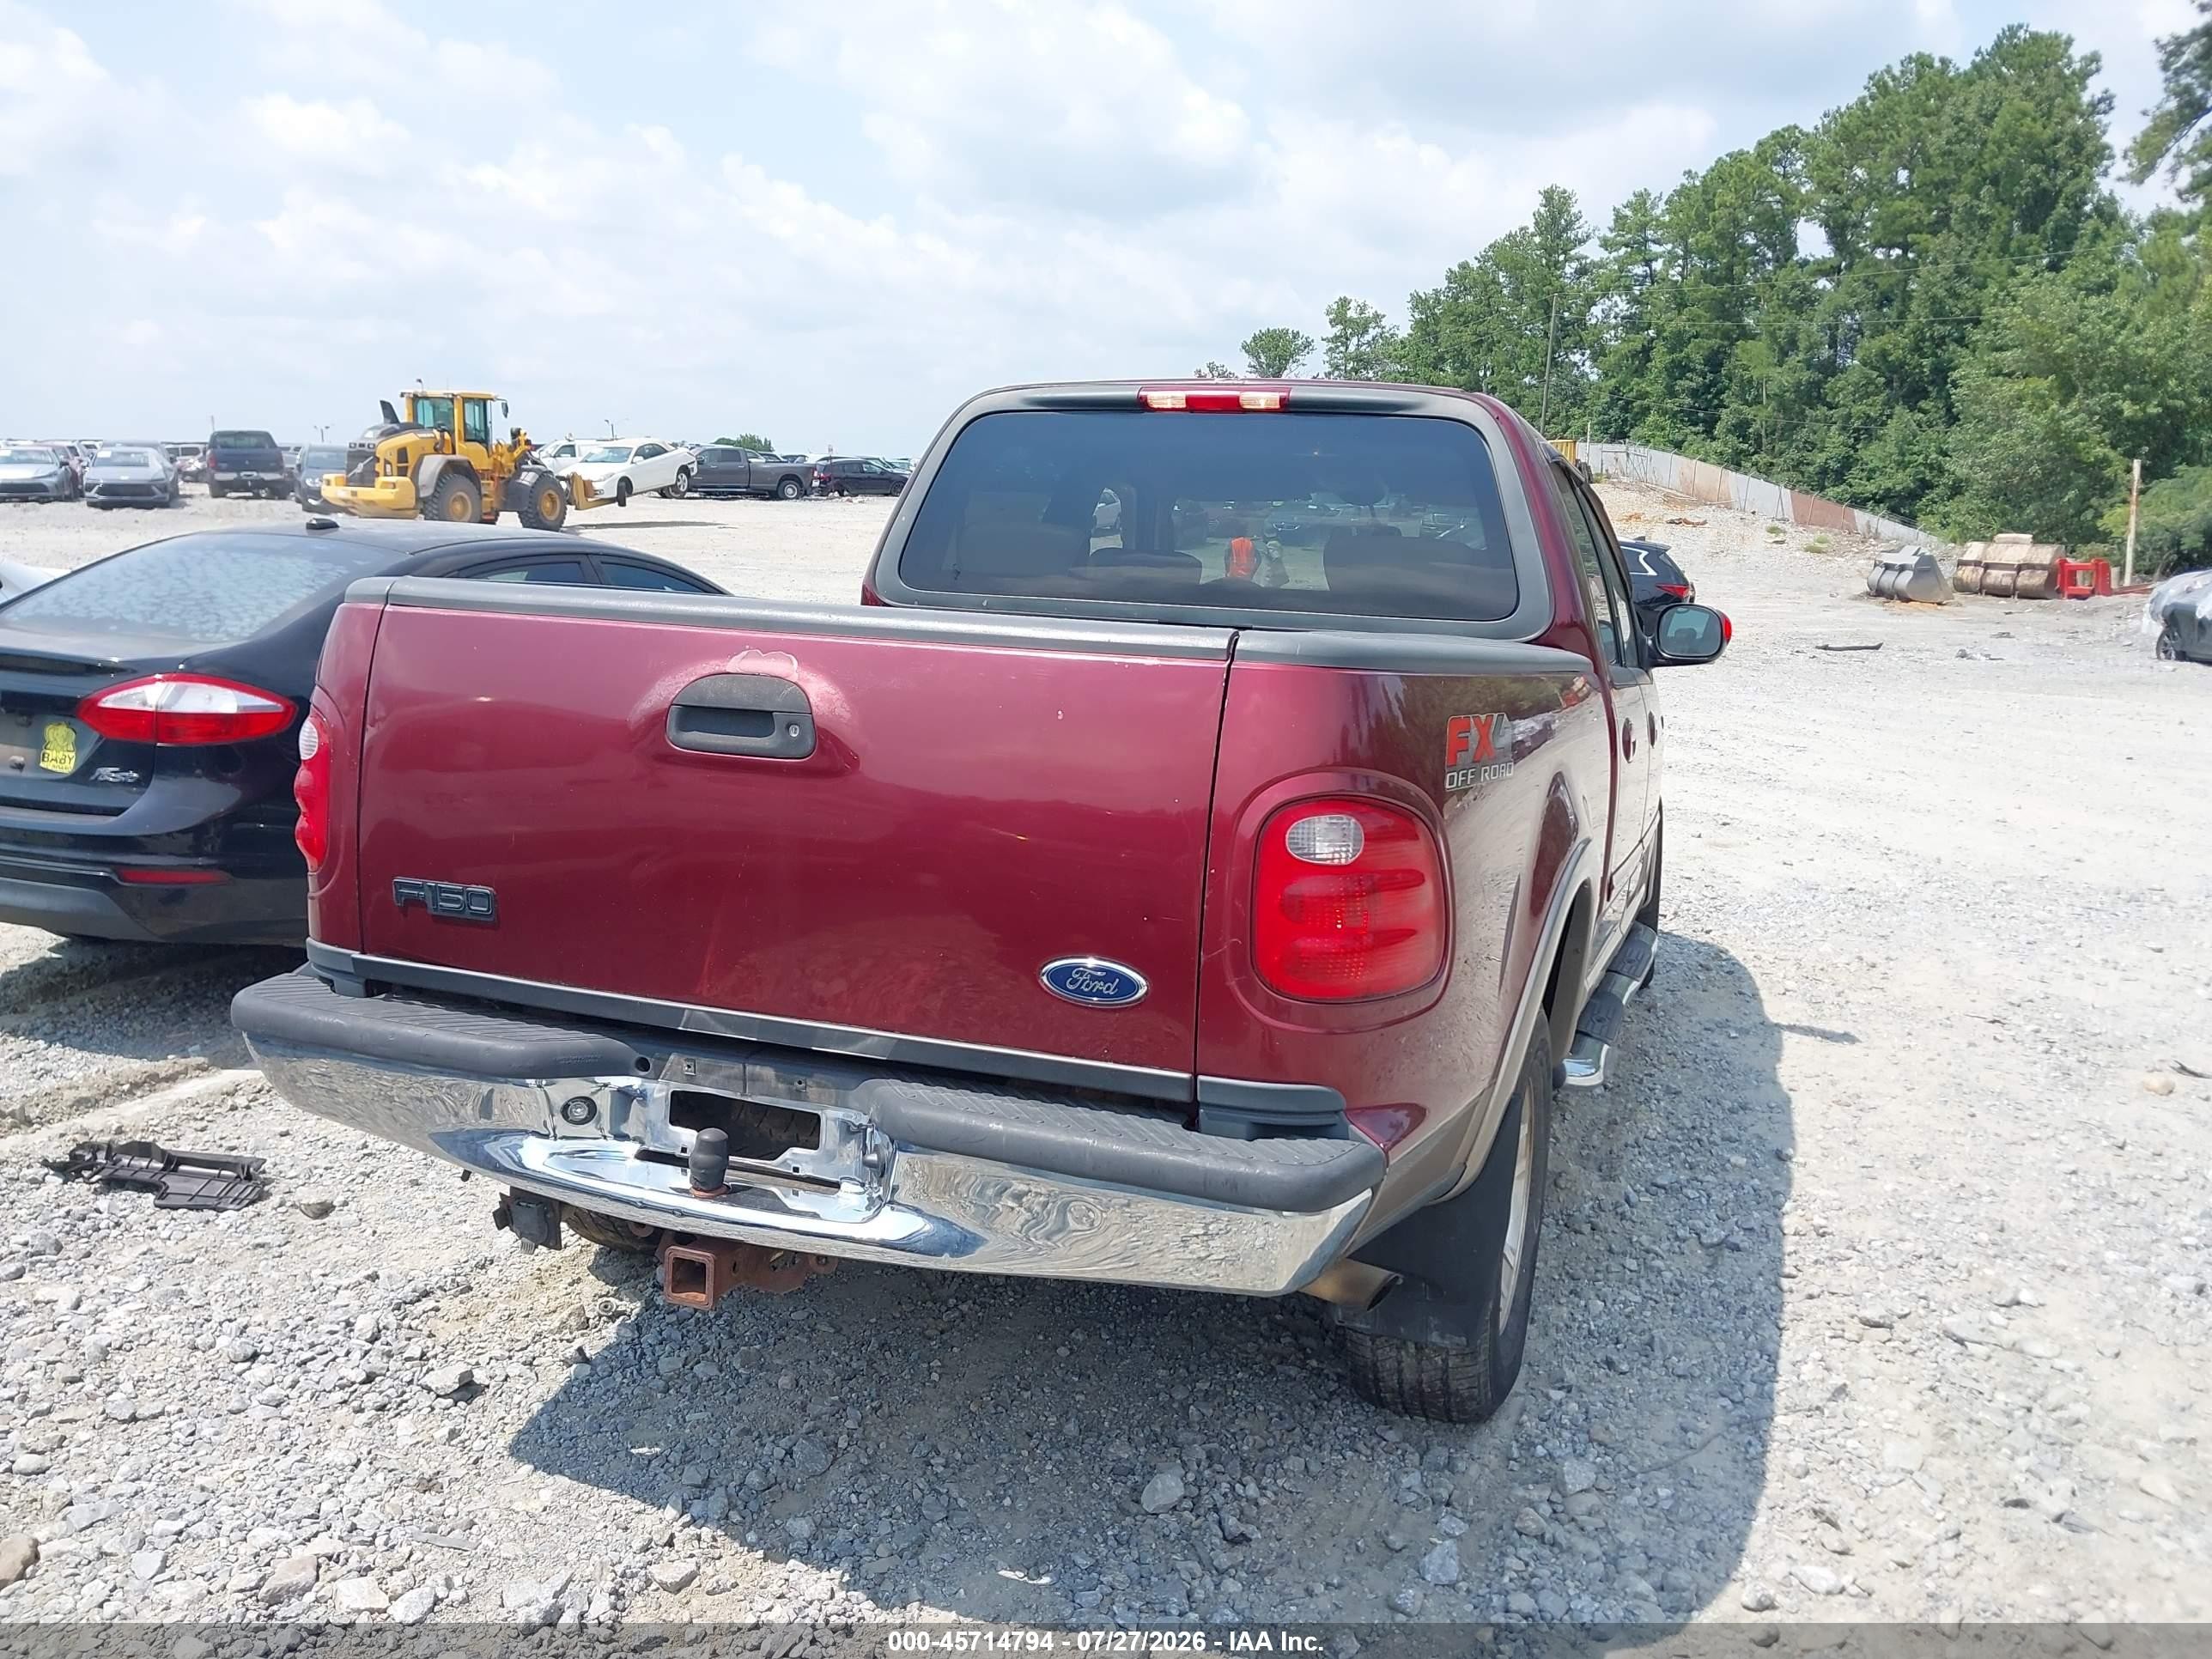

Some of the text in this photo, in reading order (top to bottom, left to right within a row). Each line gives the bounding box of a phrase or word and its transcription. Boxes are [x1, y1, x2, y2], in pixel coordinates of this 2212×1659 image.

[41, 752, 75, 764] BABY
[1445, 762, 1514, 789] OFF ROAD
[1066, 967, 1120, 995] Ford
